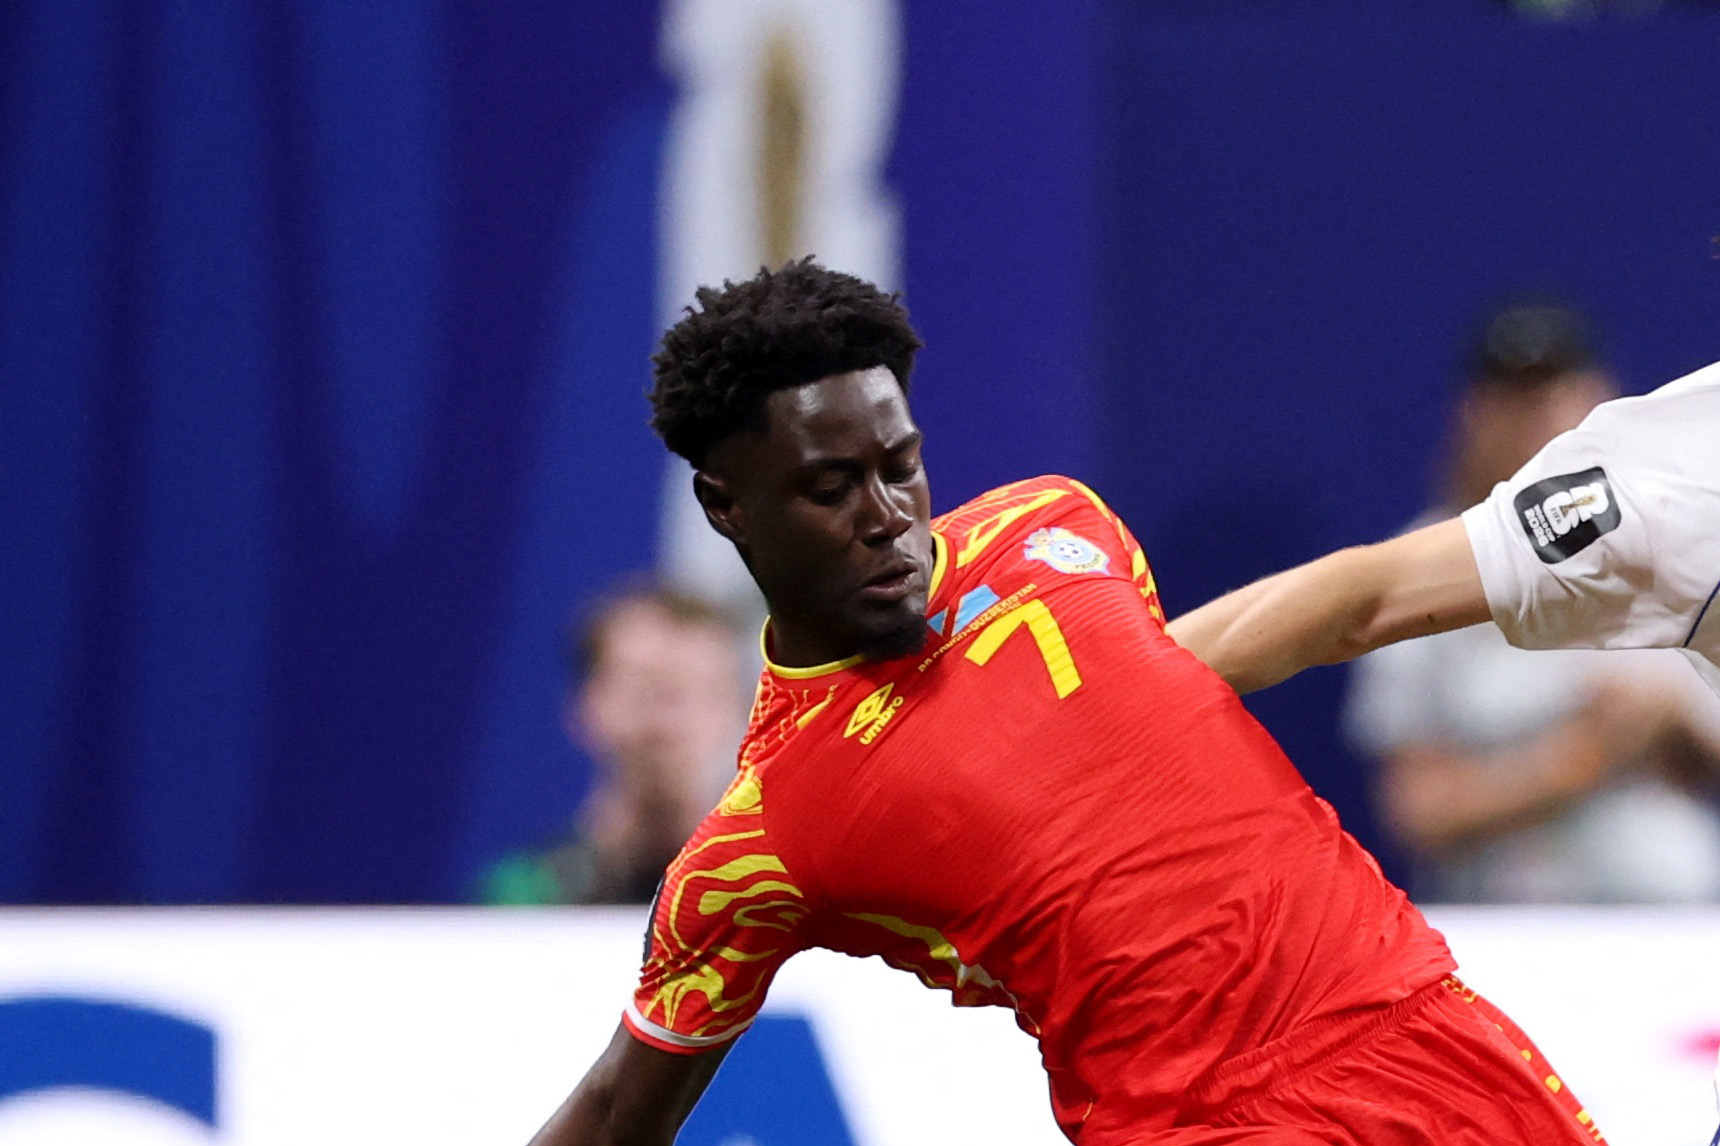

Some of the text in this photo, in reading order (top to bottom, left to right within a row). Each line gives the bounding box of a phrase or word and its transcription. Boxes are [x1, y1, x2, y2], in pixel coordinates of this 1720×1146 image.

[1523, 508, 1550, 547] 2026
[964, 599, 1083, 699] 7
[859, 695, 905, 746] umbro
